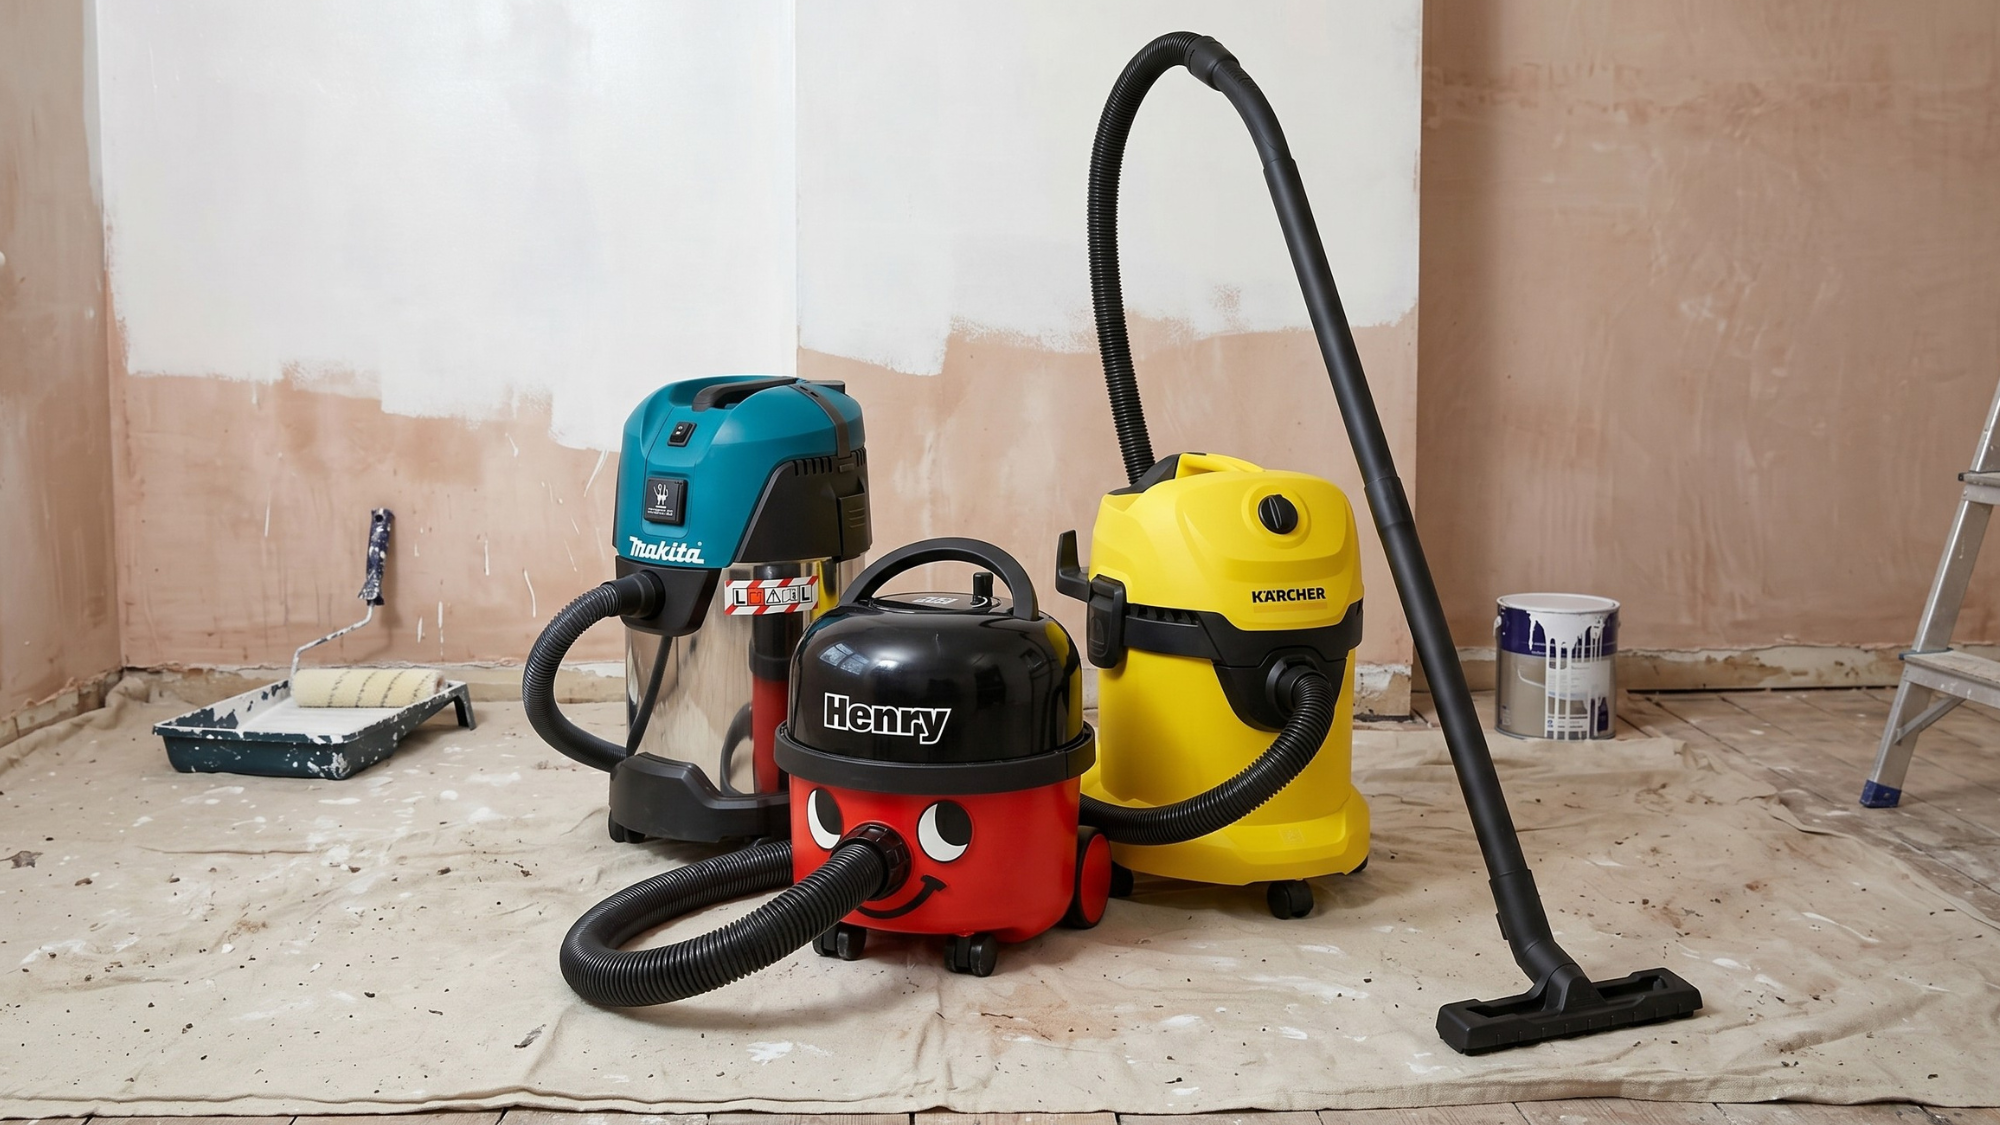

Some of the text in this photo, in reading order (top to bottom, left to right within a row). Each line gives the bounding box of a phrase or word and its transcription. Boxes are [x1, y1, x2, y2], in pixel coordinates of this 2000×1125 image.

[735, 586, 810, 605] L L
[1252, 588, 1326, 603] KÄRCHER
[824, 692, 952, 744] Henry
